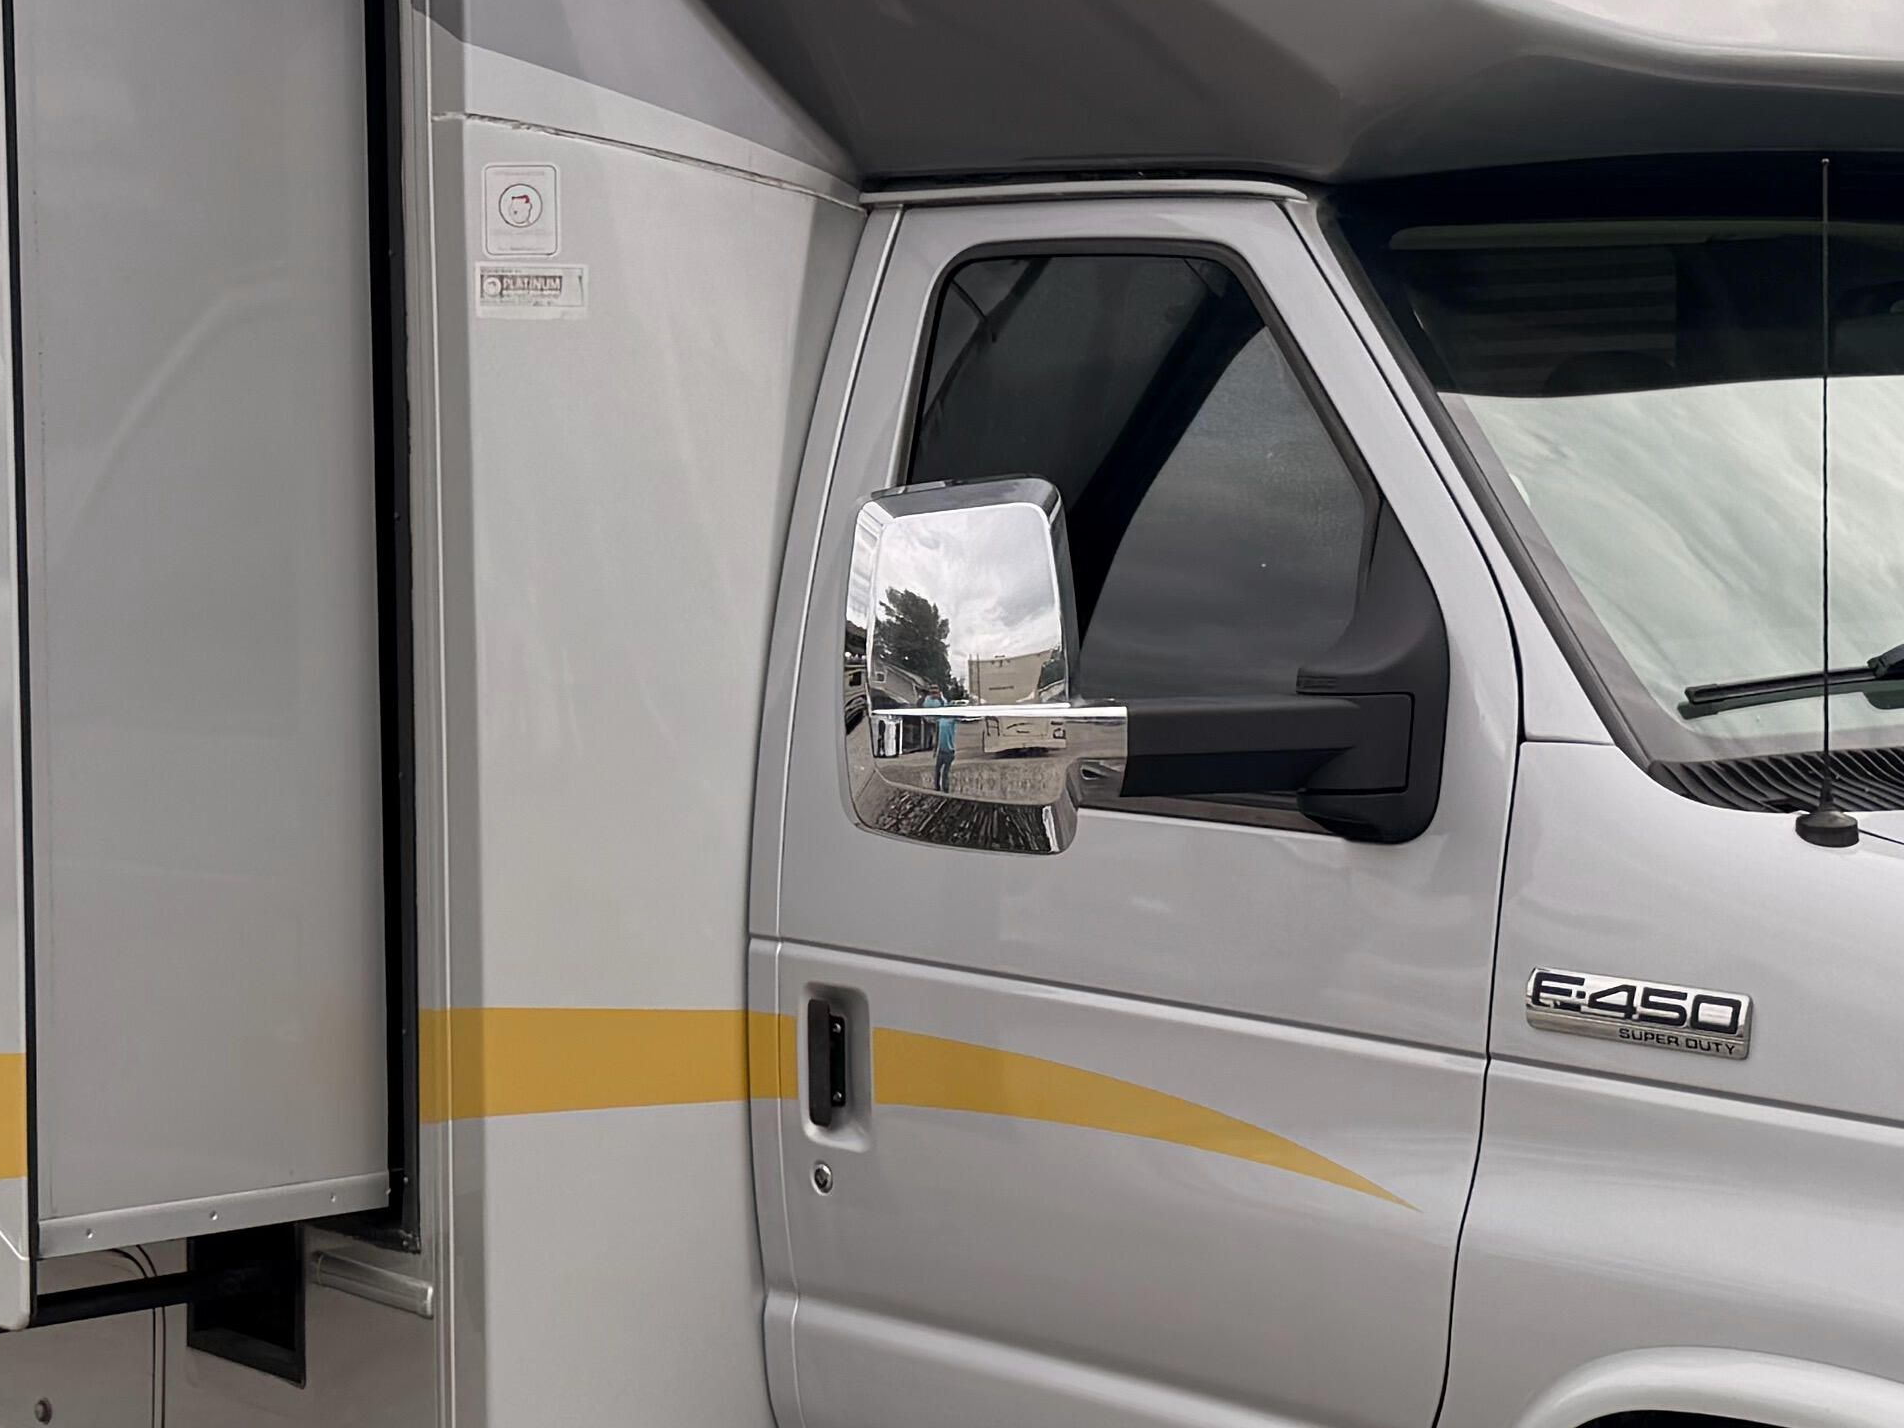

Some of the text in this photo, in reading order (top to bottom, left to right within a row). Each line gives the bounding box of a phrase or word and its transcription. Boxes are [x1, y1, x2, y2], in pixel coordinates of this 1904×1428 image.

[1532, 971, 1743, 1035] E-450
[1618, 1027, 1736, 1056] SUPER DUTY
